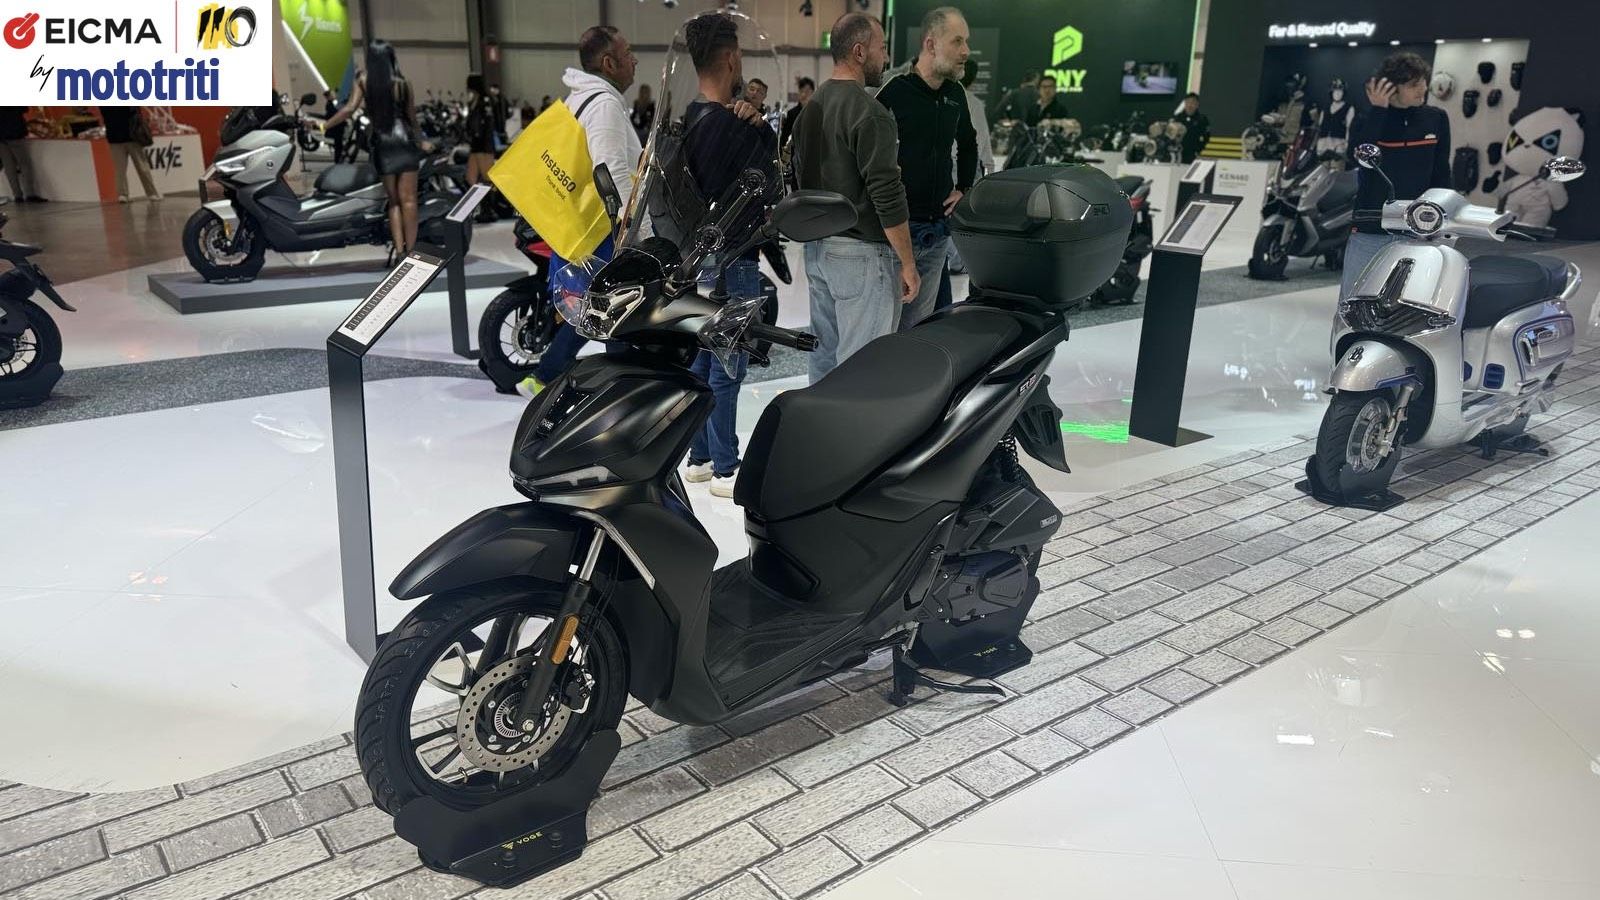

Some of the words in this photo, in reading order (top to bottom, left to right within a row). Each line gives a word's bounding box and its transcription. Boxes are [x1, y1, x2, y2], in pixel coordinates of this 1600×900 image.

[1337, 21, 1376, 37] Quality
[541, 149, 577, 193] Insta360
[516, 831, 543, 845] VOGE
